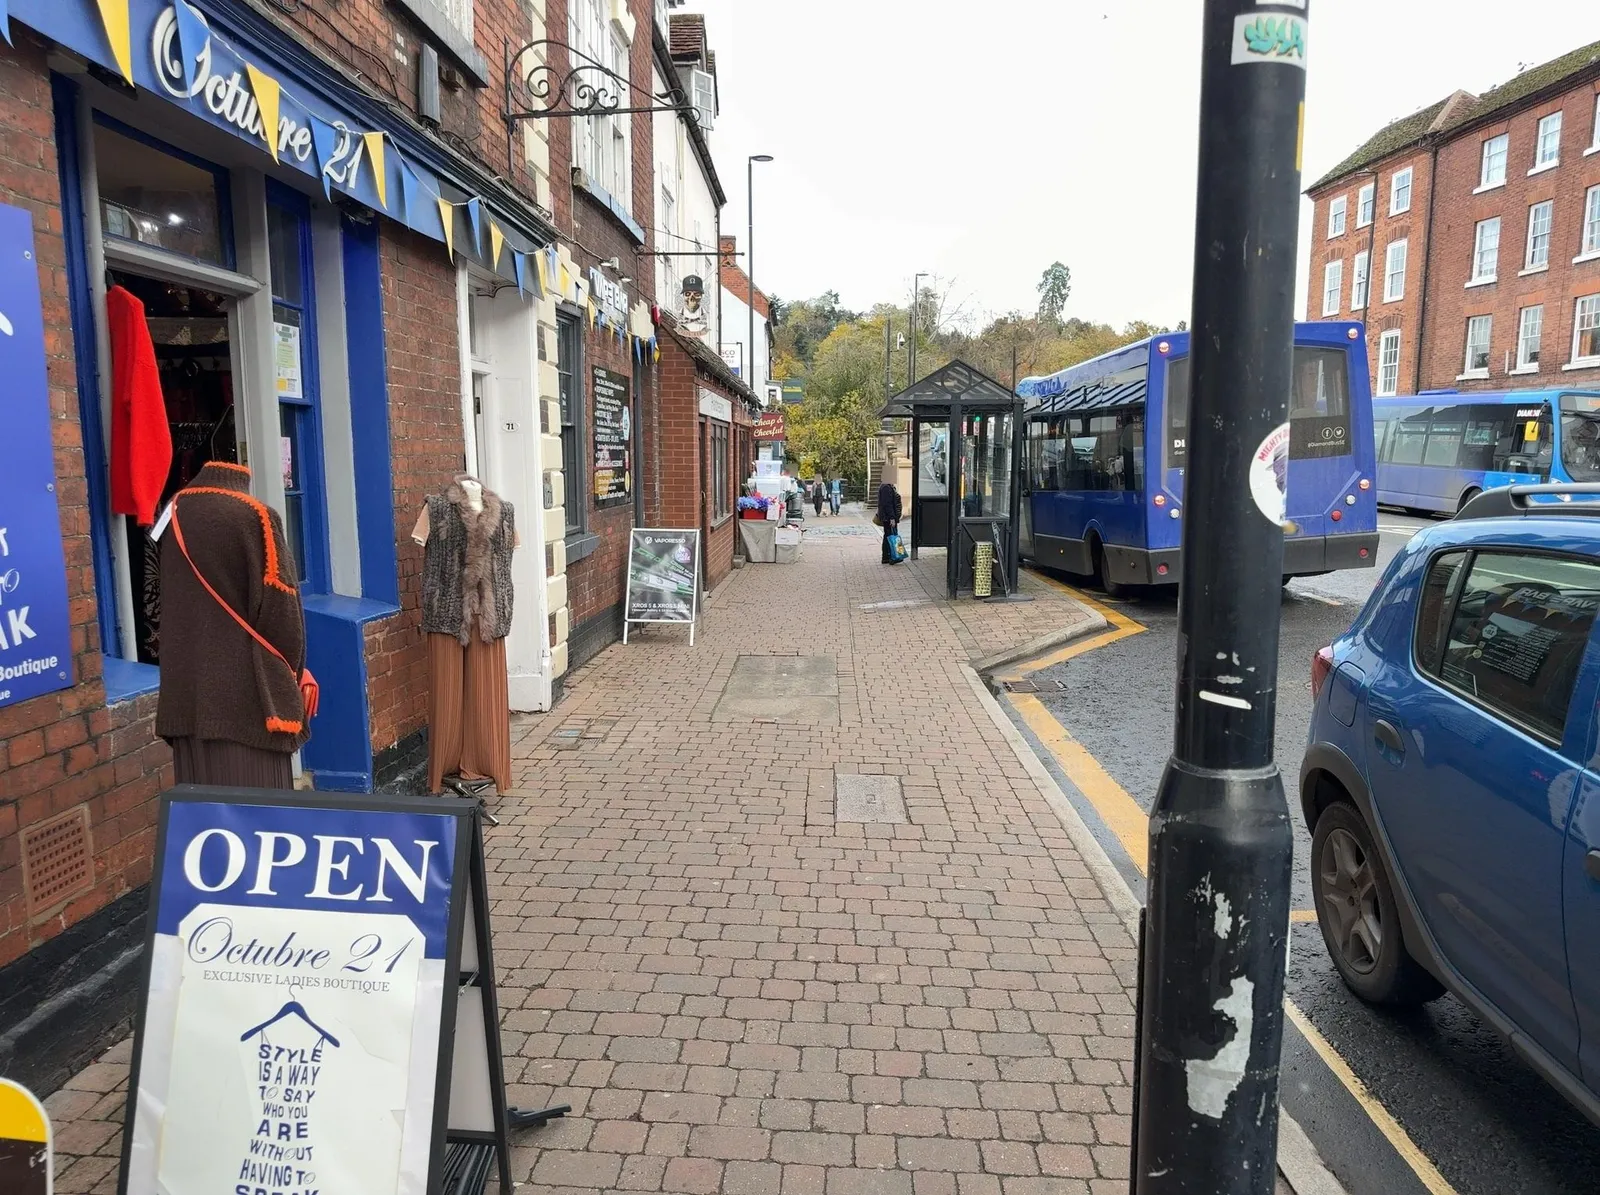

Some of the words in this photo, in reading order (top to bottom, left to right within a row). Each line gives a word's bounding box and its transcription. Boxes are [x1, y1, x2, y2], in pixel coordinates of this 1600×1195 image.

[152, 4, 313, 162] Octure
[323, 121, 366, 189] 21
[753, 425, 784, 437] Cheerful
[1258, 432, 1282, 461] MIGHTY
[183, 828, 439, 904] OPEN
[188, 916, 331, 969] Octubre
[341, 933, 415, 973] 21
[203, 970, 272, 984] EXCLUSIVE
[275, 974, 320, 988] LADIES
[323, 978, 390, 994] BOUTIQUE
[258, 1043, 322, 1064] STYLE
[259, 1061, 272, 1082] IS
[274, 1066, 283, 1085] A
[288, 1065, 320, 1086] WAY
[259, 1085, 279, 1100] TO
[283, 1088, 315, 1103] SAY
[263, 1102, 284, 1118] WHO
[288, 1105, 308, 1119] YOU
[257, 1119, 309, 1141] ARE
[250, 1139, 313, 1161] WITHOUT
[239, 1158, 292, 1187] HAVING
[296, 1170, 316, 1186] TO
